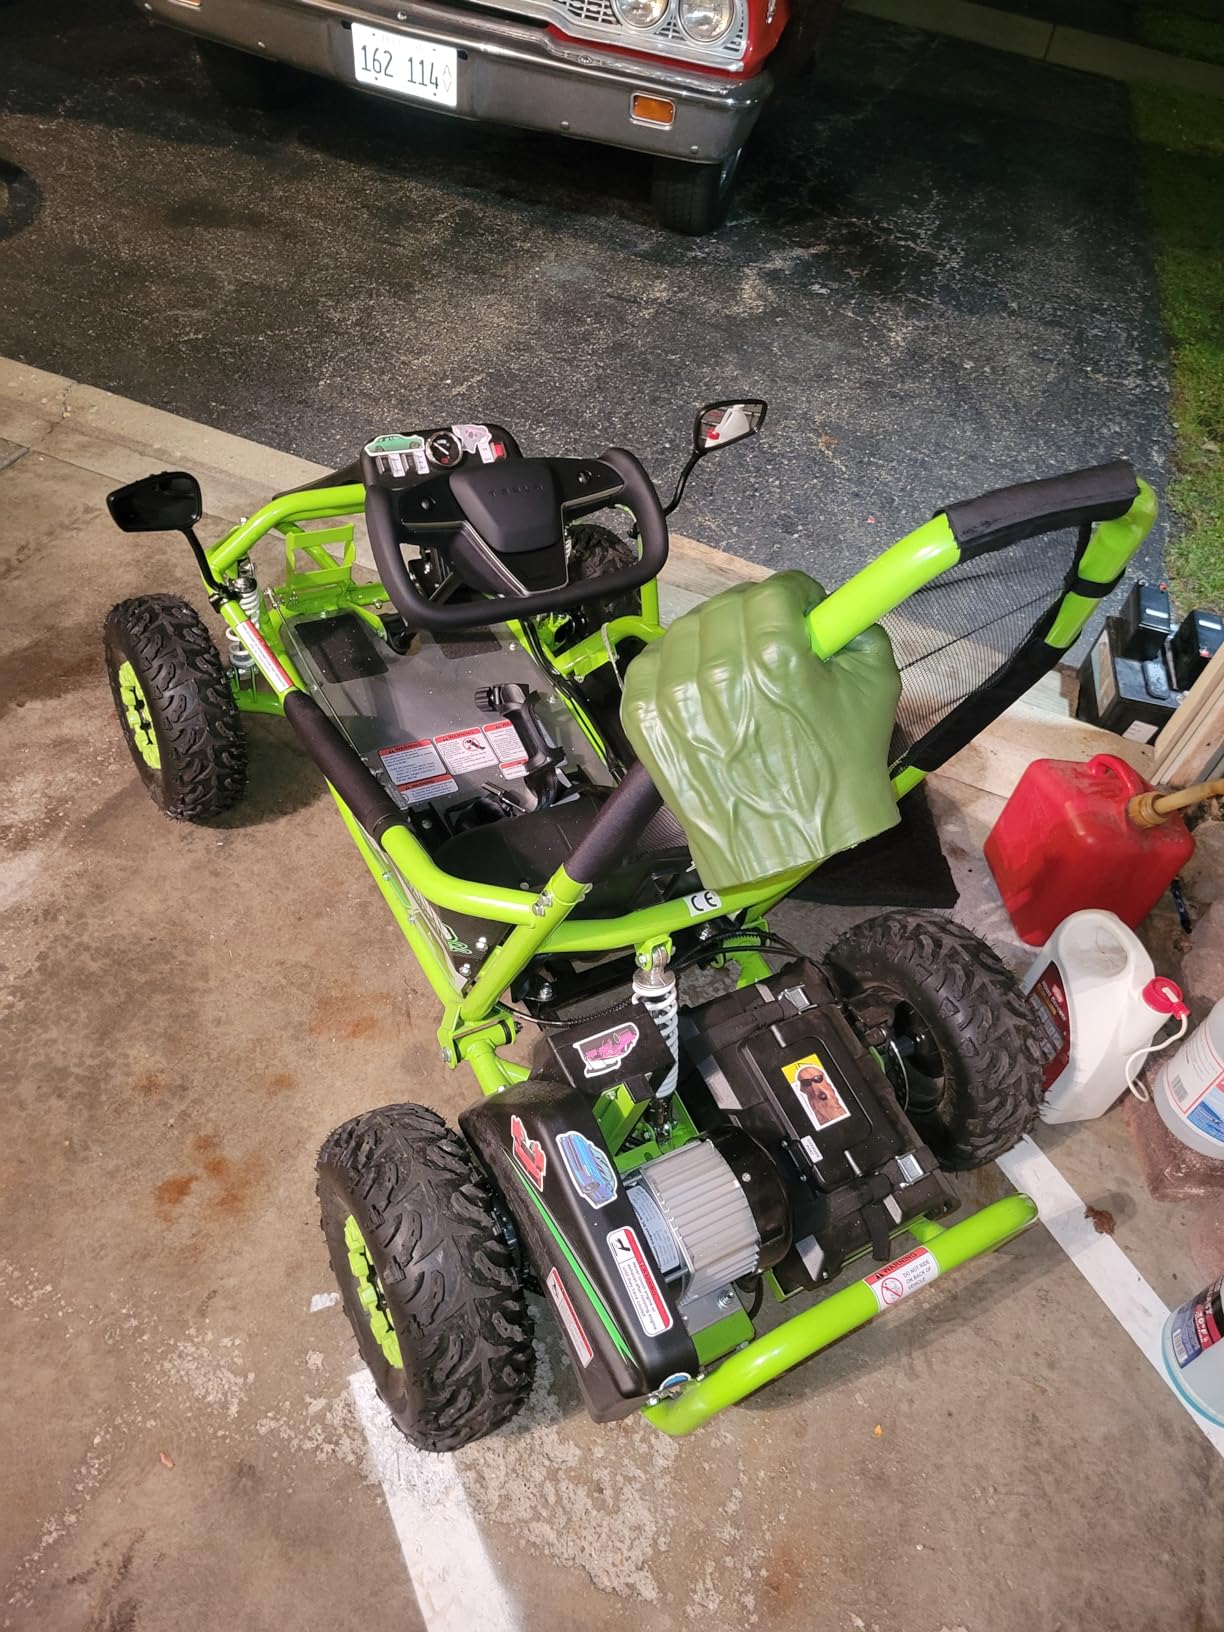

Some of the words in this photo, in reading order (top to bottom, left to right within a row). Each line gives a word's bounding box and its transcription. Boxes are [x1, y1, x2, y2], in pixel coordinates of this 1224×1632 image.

[361, 45, 394, 78] 162
[407, 56, 439, 90] 114
[691, 891, 717, 911] CE
[883, 1252, 917, 1273] WARNING
[910, 1265, 919, 1273] NOT
[641, 1268, 656, 1296] WARNING
[913, 1271, 925, 1280] BACK
